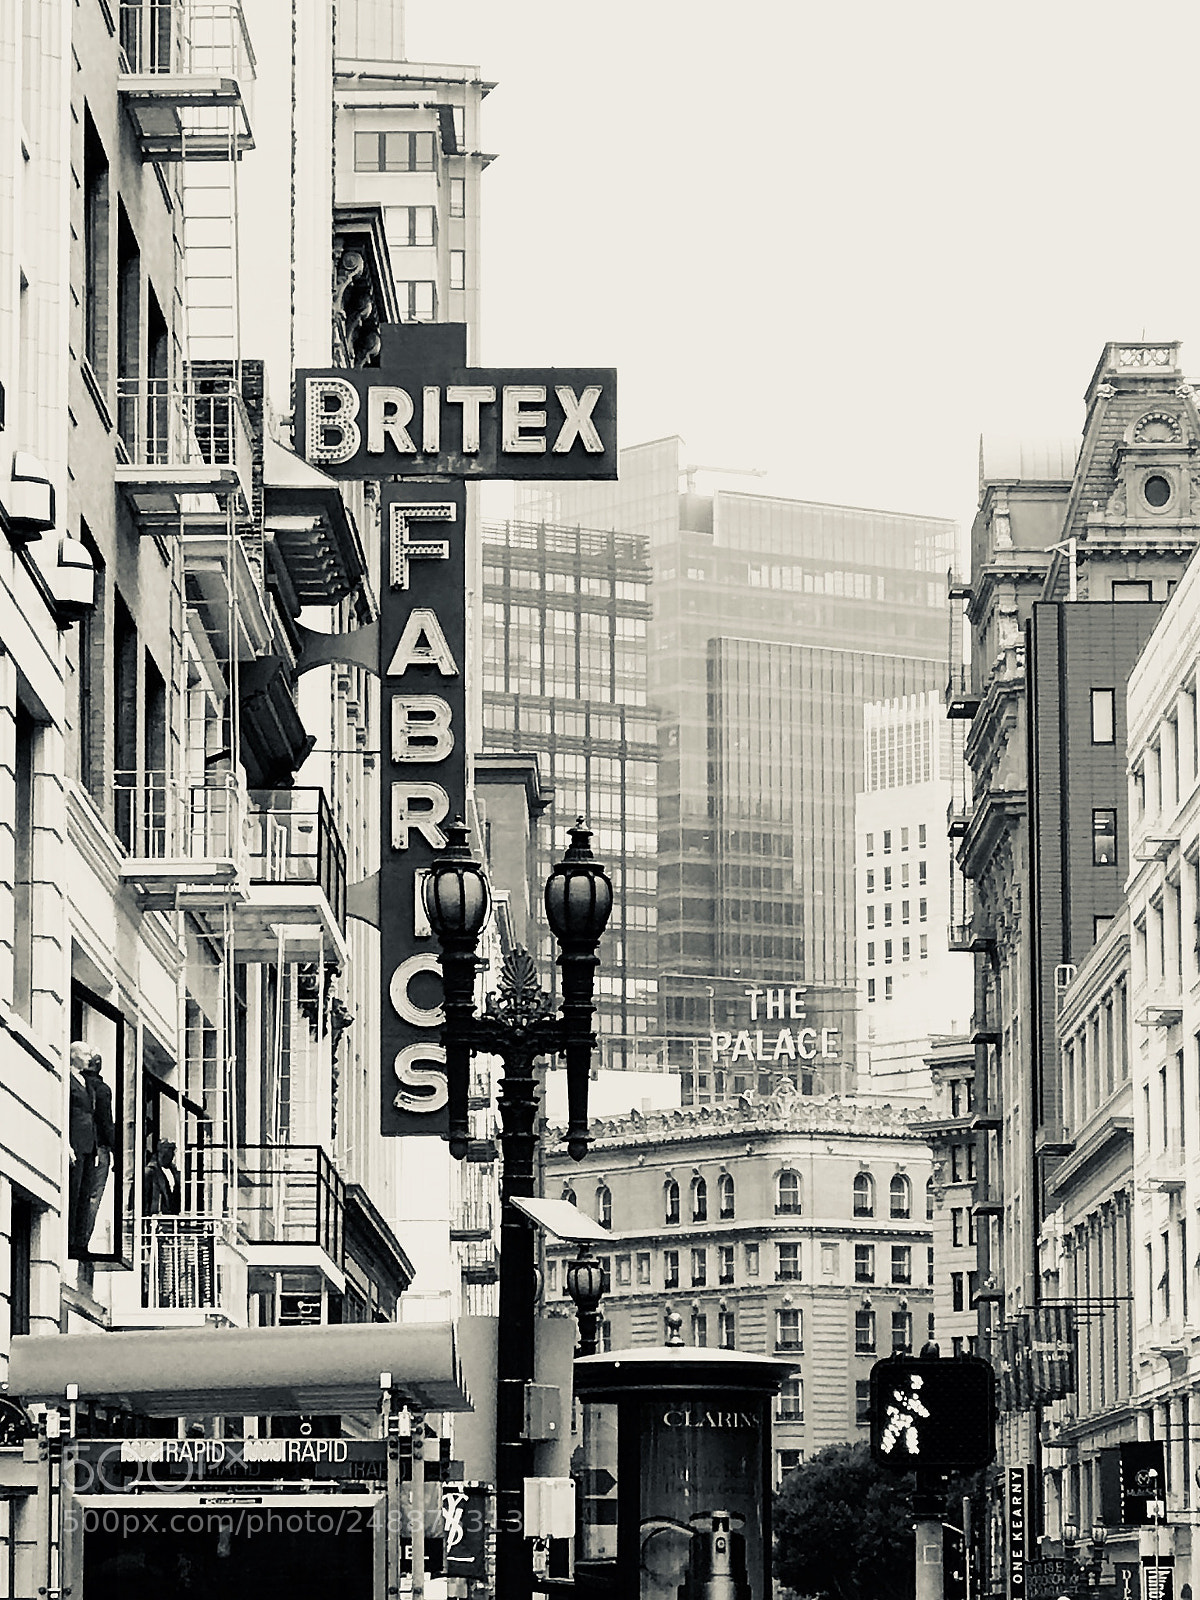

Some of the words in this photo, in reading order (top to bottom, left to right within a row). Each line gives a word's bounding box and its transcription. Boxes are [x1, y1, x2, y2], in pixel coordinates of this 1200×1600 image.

[305, 377, 605, 464] BRITEX
[387, 502, 459, 1112] FABRICS
[745, 988, 807, 1020] THE
[711, 1027, 838, 1062] PALACE
[663, 1410, 760, 1428] CLARINS
[166, 1441, 226, 1462] RAPID
[288, 1440, 348, 1462] RAPID
[1011, 1471, 1023, 1541] KEARNY
[1012, 1549, 1023, 1584] ONE
